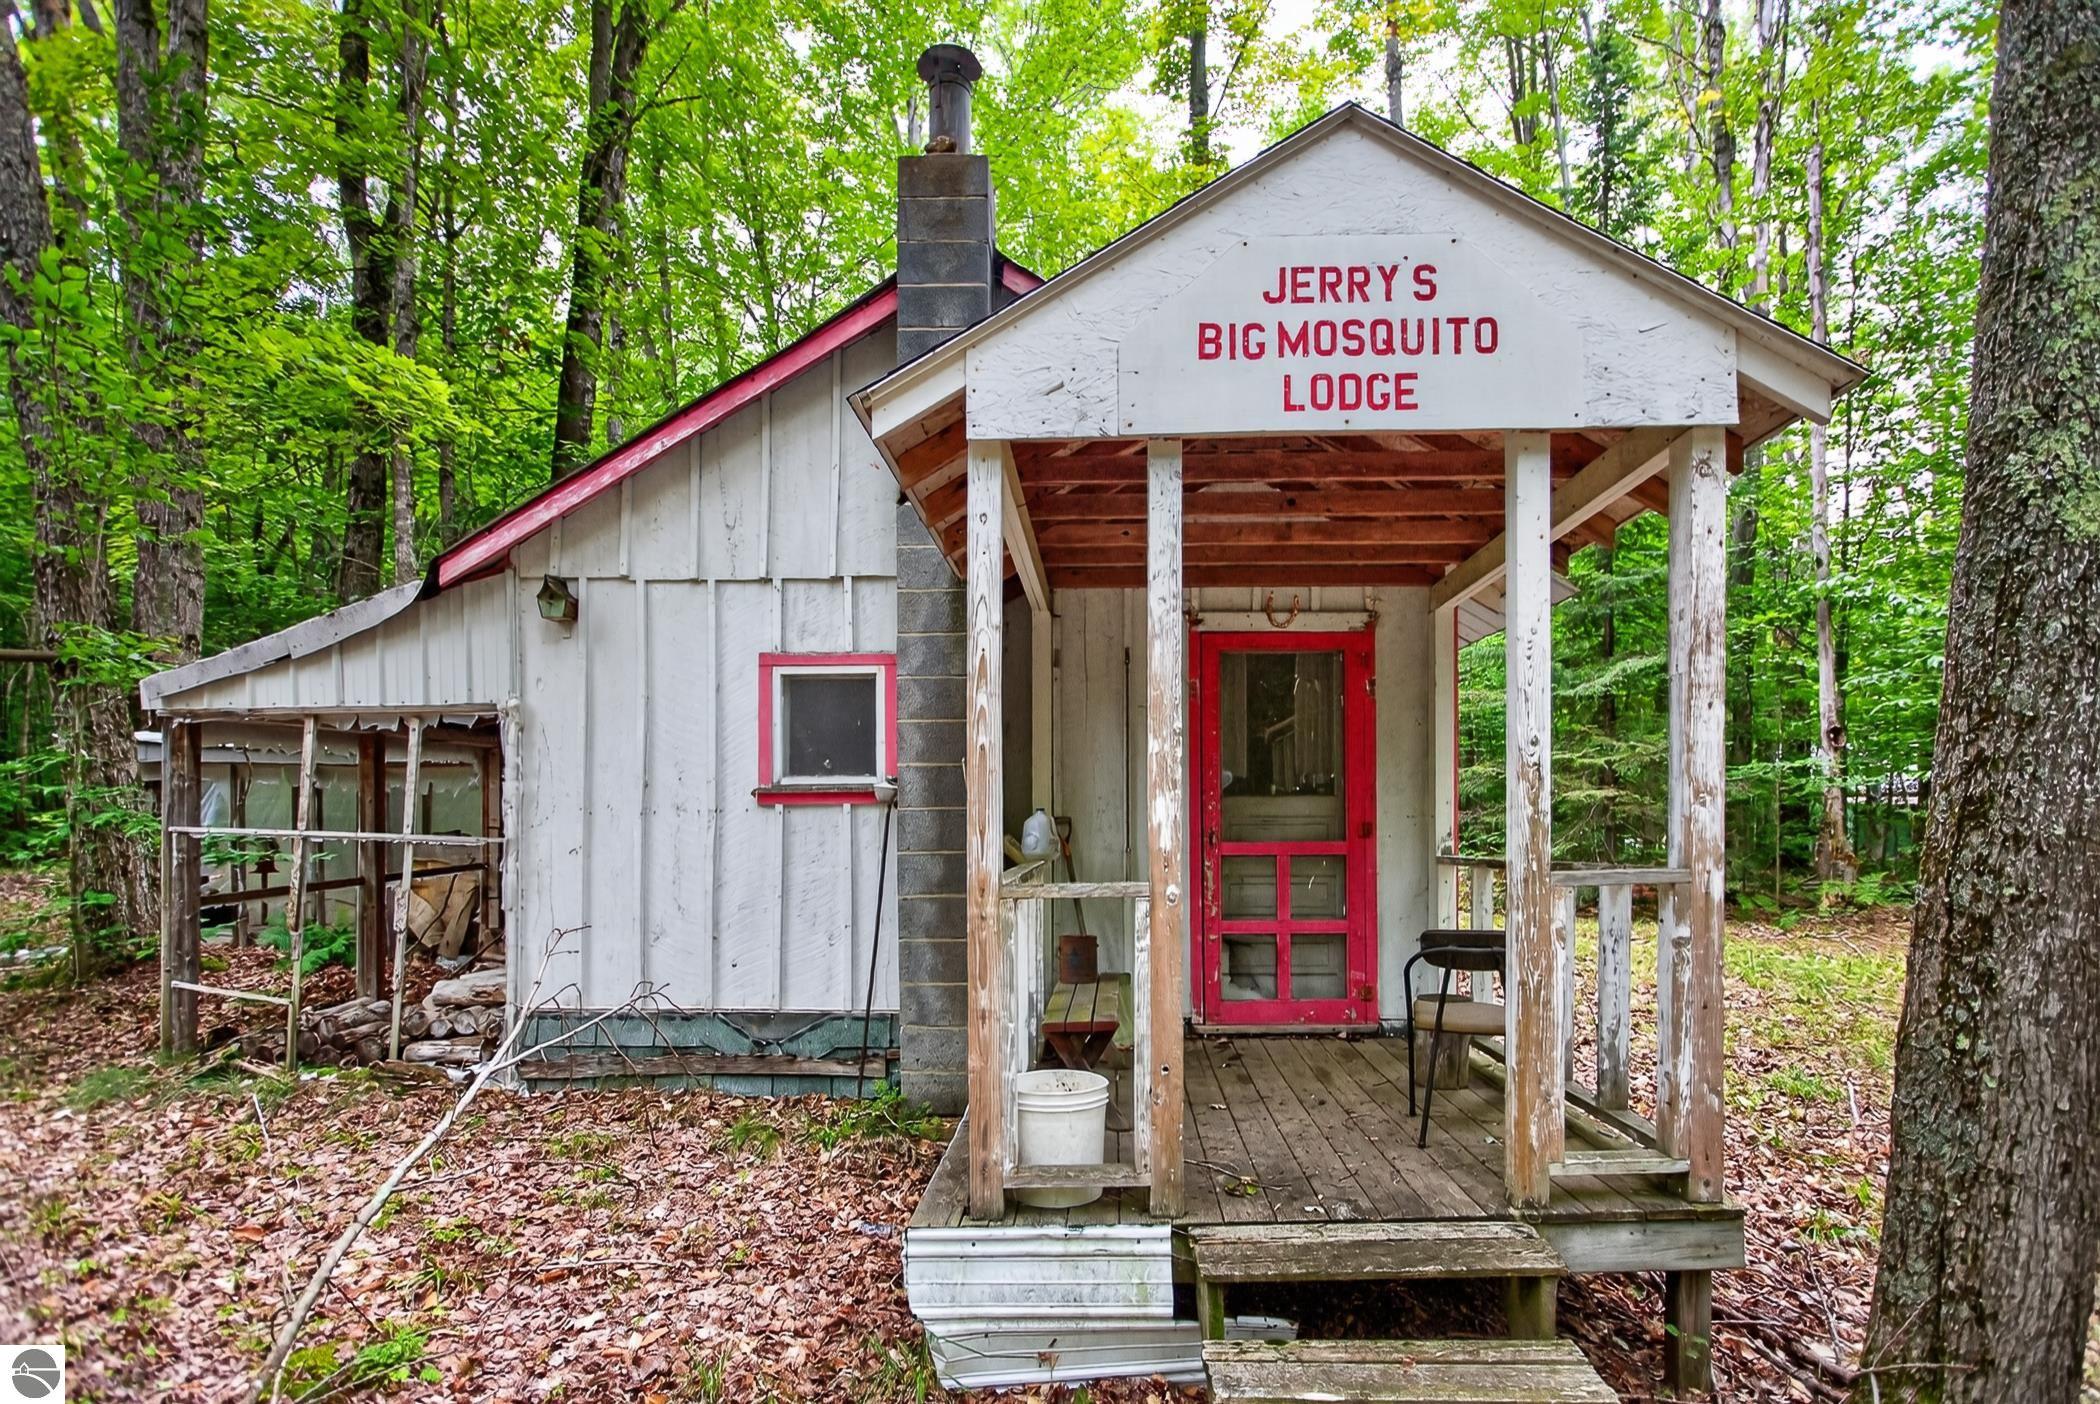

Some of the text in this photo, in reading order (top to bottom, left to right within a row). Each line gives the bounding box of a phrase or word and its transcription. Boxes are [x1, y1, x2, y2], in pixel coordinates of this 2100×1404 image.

[1197, 316, 1498, 361] BIG MOSQUITO
[1283, 372, 1419, 412] LODGE
